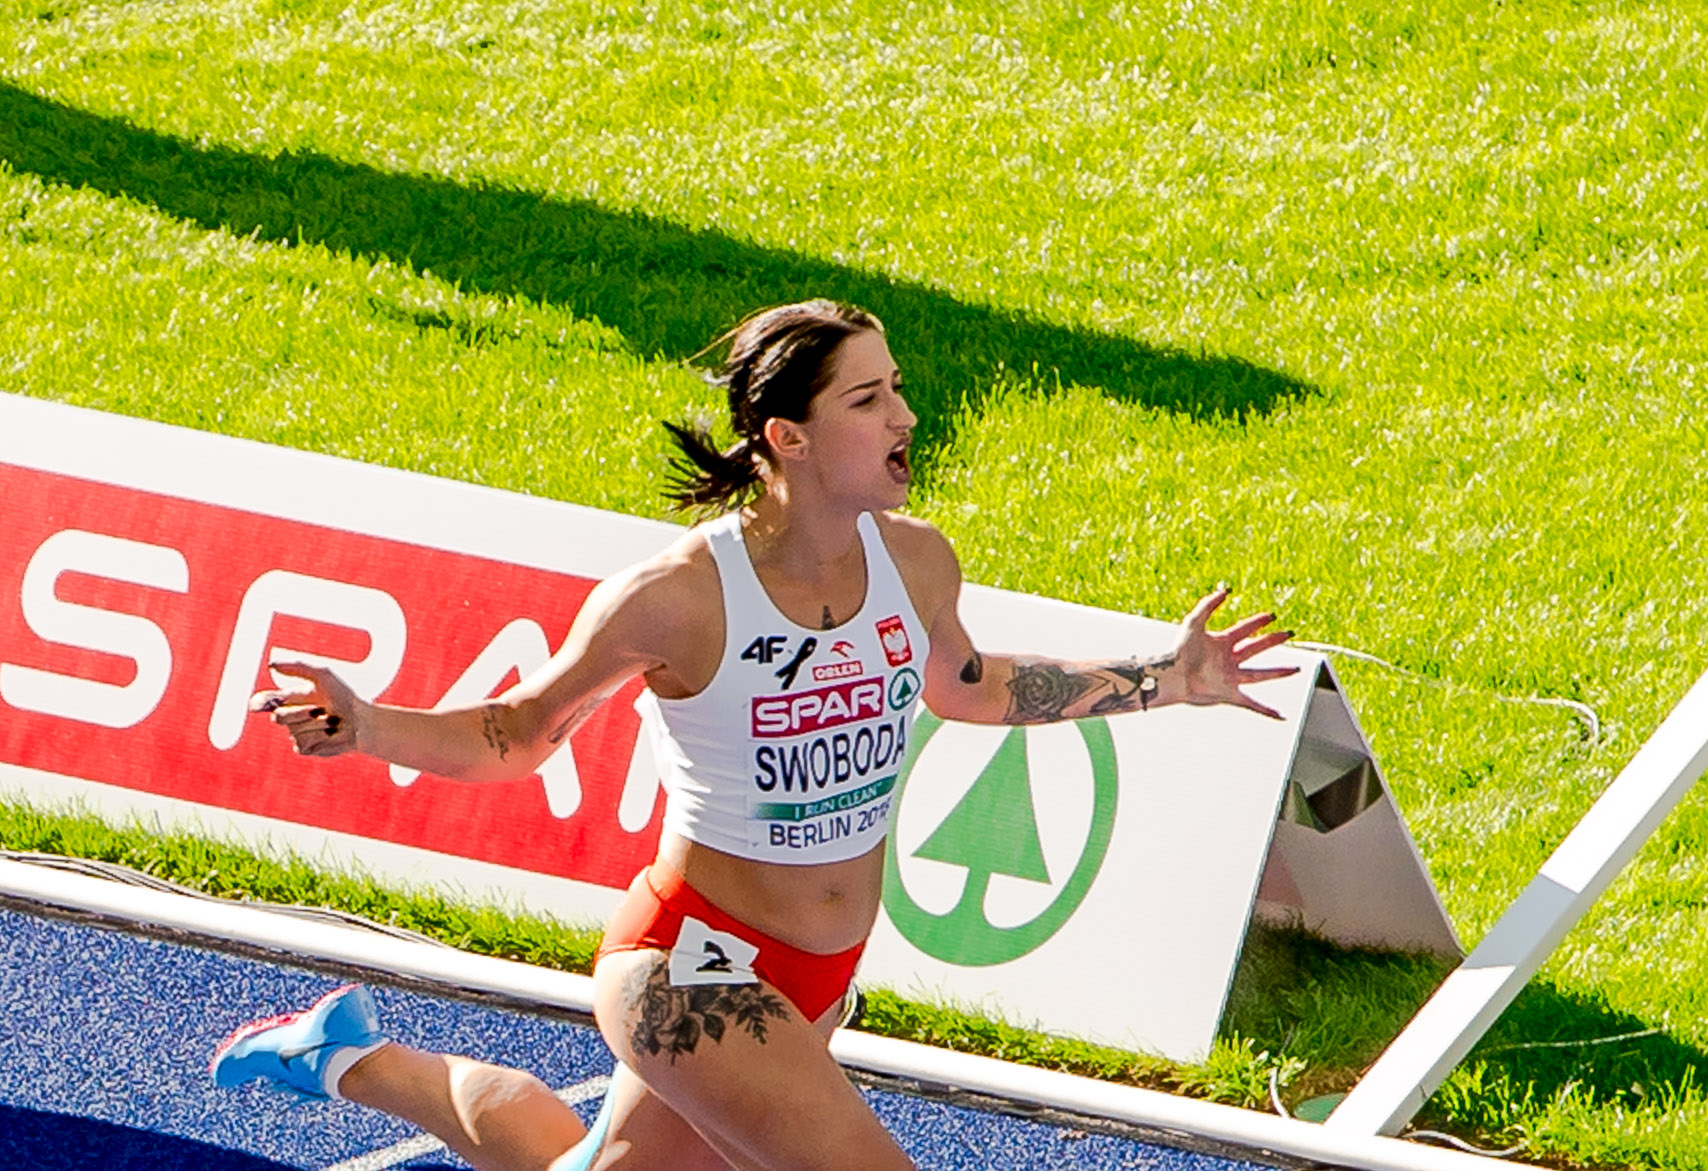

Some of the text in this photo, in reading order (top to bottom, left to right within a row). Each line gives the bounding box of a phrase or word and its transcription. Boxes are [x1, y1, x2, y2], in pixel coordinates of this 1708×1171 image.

[741, 635, 788, 664] 4F
[0, 529, 661, 833] SPA
[815, 662, 861, 680] ORLEN
[756, 683, 882, 733] SPAR
[755, 716, 905, 793] SWOBODA
[805, 798, 835, 817] RUN
[769, 814, 851, 849] BERLIN
[695, 940, 733, 974] 2
